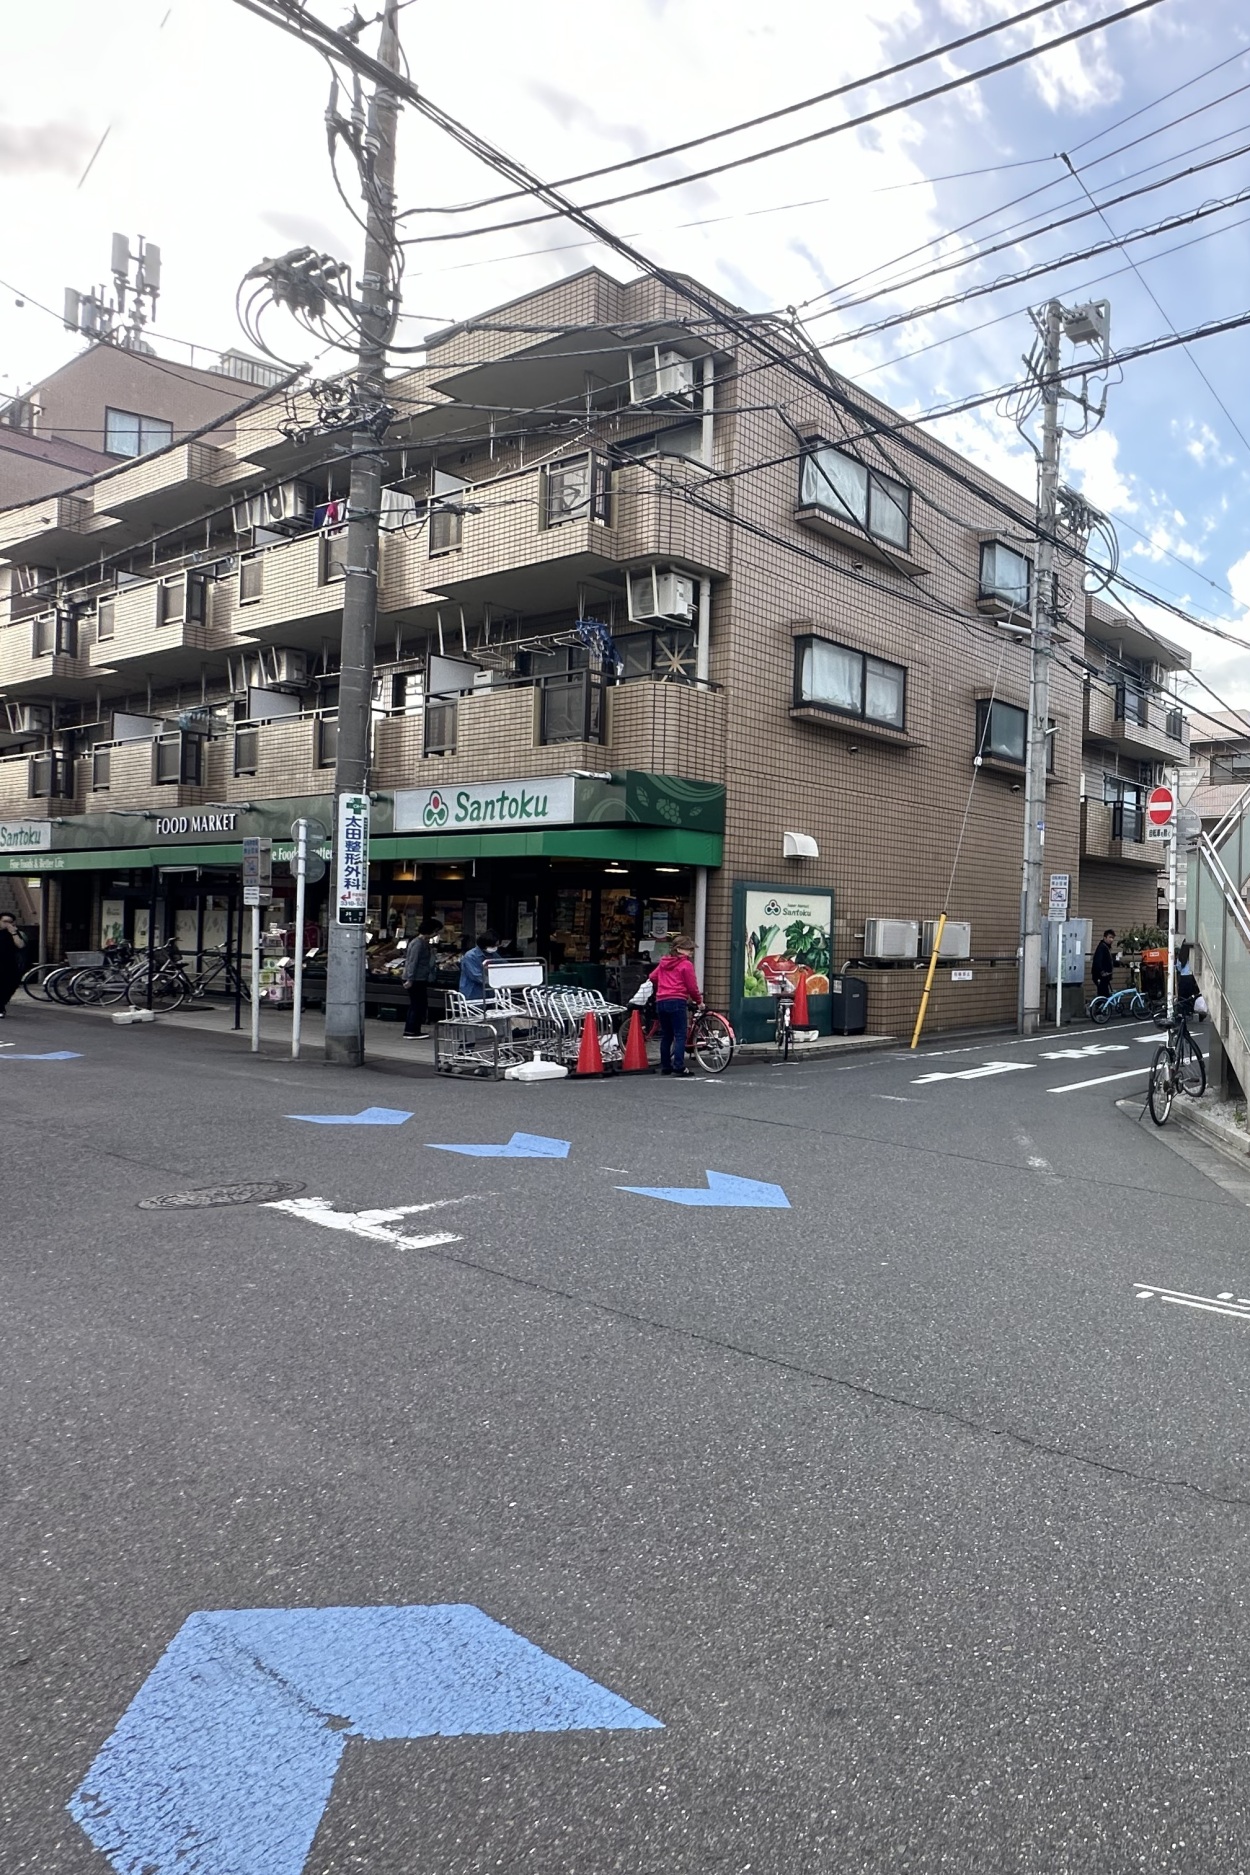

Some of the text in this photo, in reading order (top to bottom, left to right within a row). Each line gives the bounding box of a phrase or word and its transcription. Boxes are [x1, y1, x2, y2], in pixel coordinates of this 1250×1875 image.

[455, 789, 549, 822] Santoku
[156, 813, 237, 834] FOOD MARKET
[0, 826, 42, 847] Santoku
[345, 816, 362, 890] 太田整形外科
[783, 908, 812, 917] Santoku
